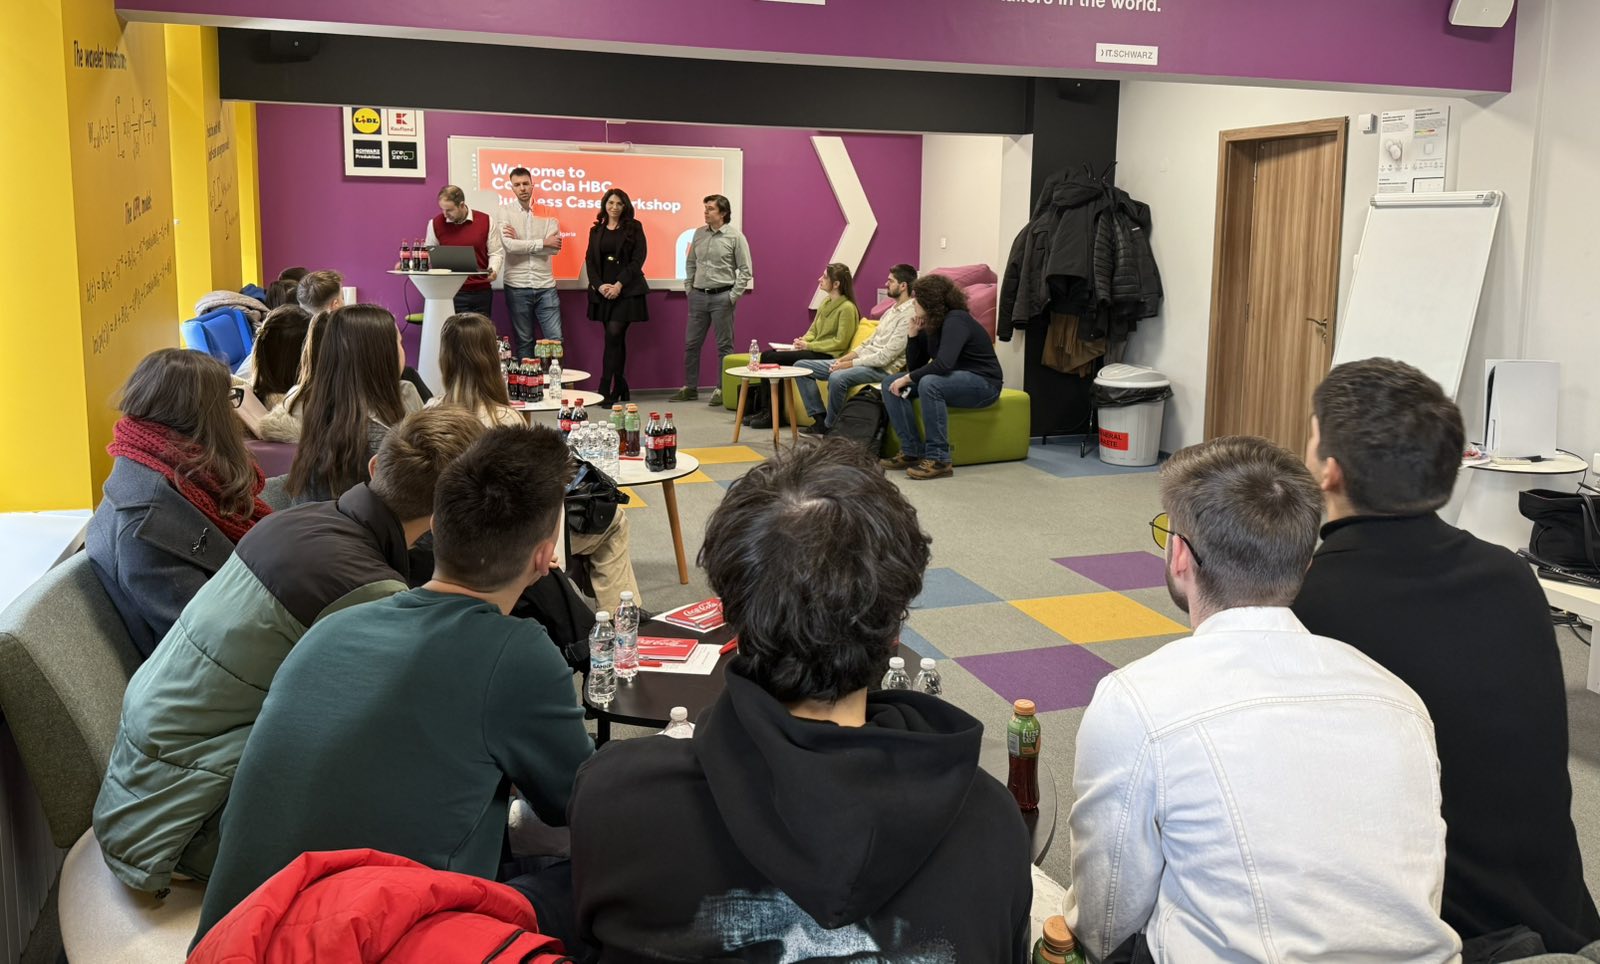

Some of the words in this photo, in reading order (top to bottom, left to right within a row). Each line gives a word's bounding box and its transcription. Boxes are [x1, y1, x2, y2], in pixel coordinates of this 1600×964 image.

[1111, 0, 1161, 12] world.
[73, 40, 84, 68] The
[1105, 49, 1153, 60] IT.SCHWARZ
[491, 162, 565, 178] Weome
[568, 167, 585, 178] to
[492, 177, 575, 192] Co-Cola
[579, 180, 612, 193] HBC
[566, 195, 602, 209] Case
[631, 198, 681, 214] rkshop
